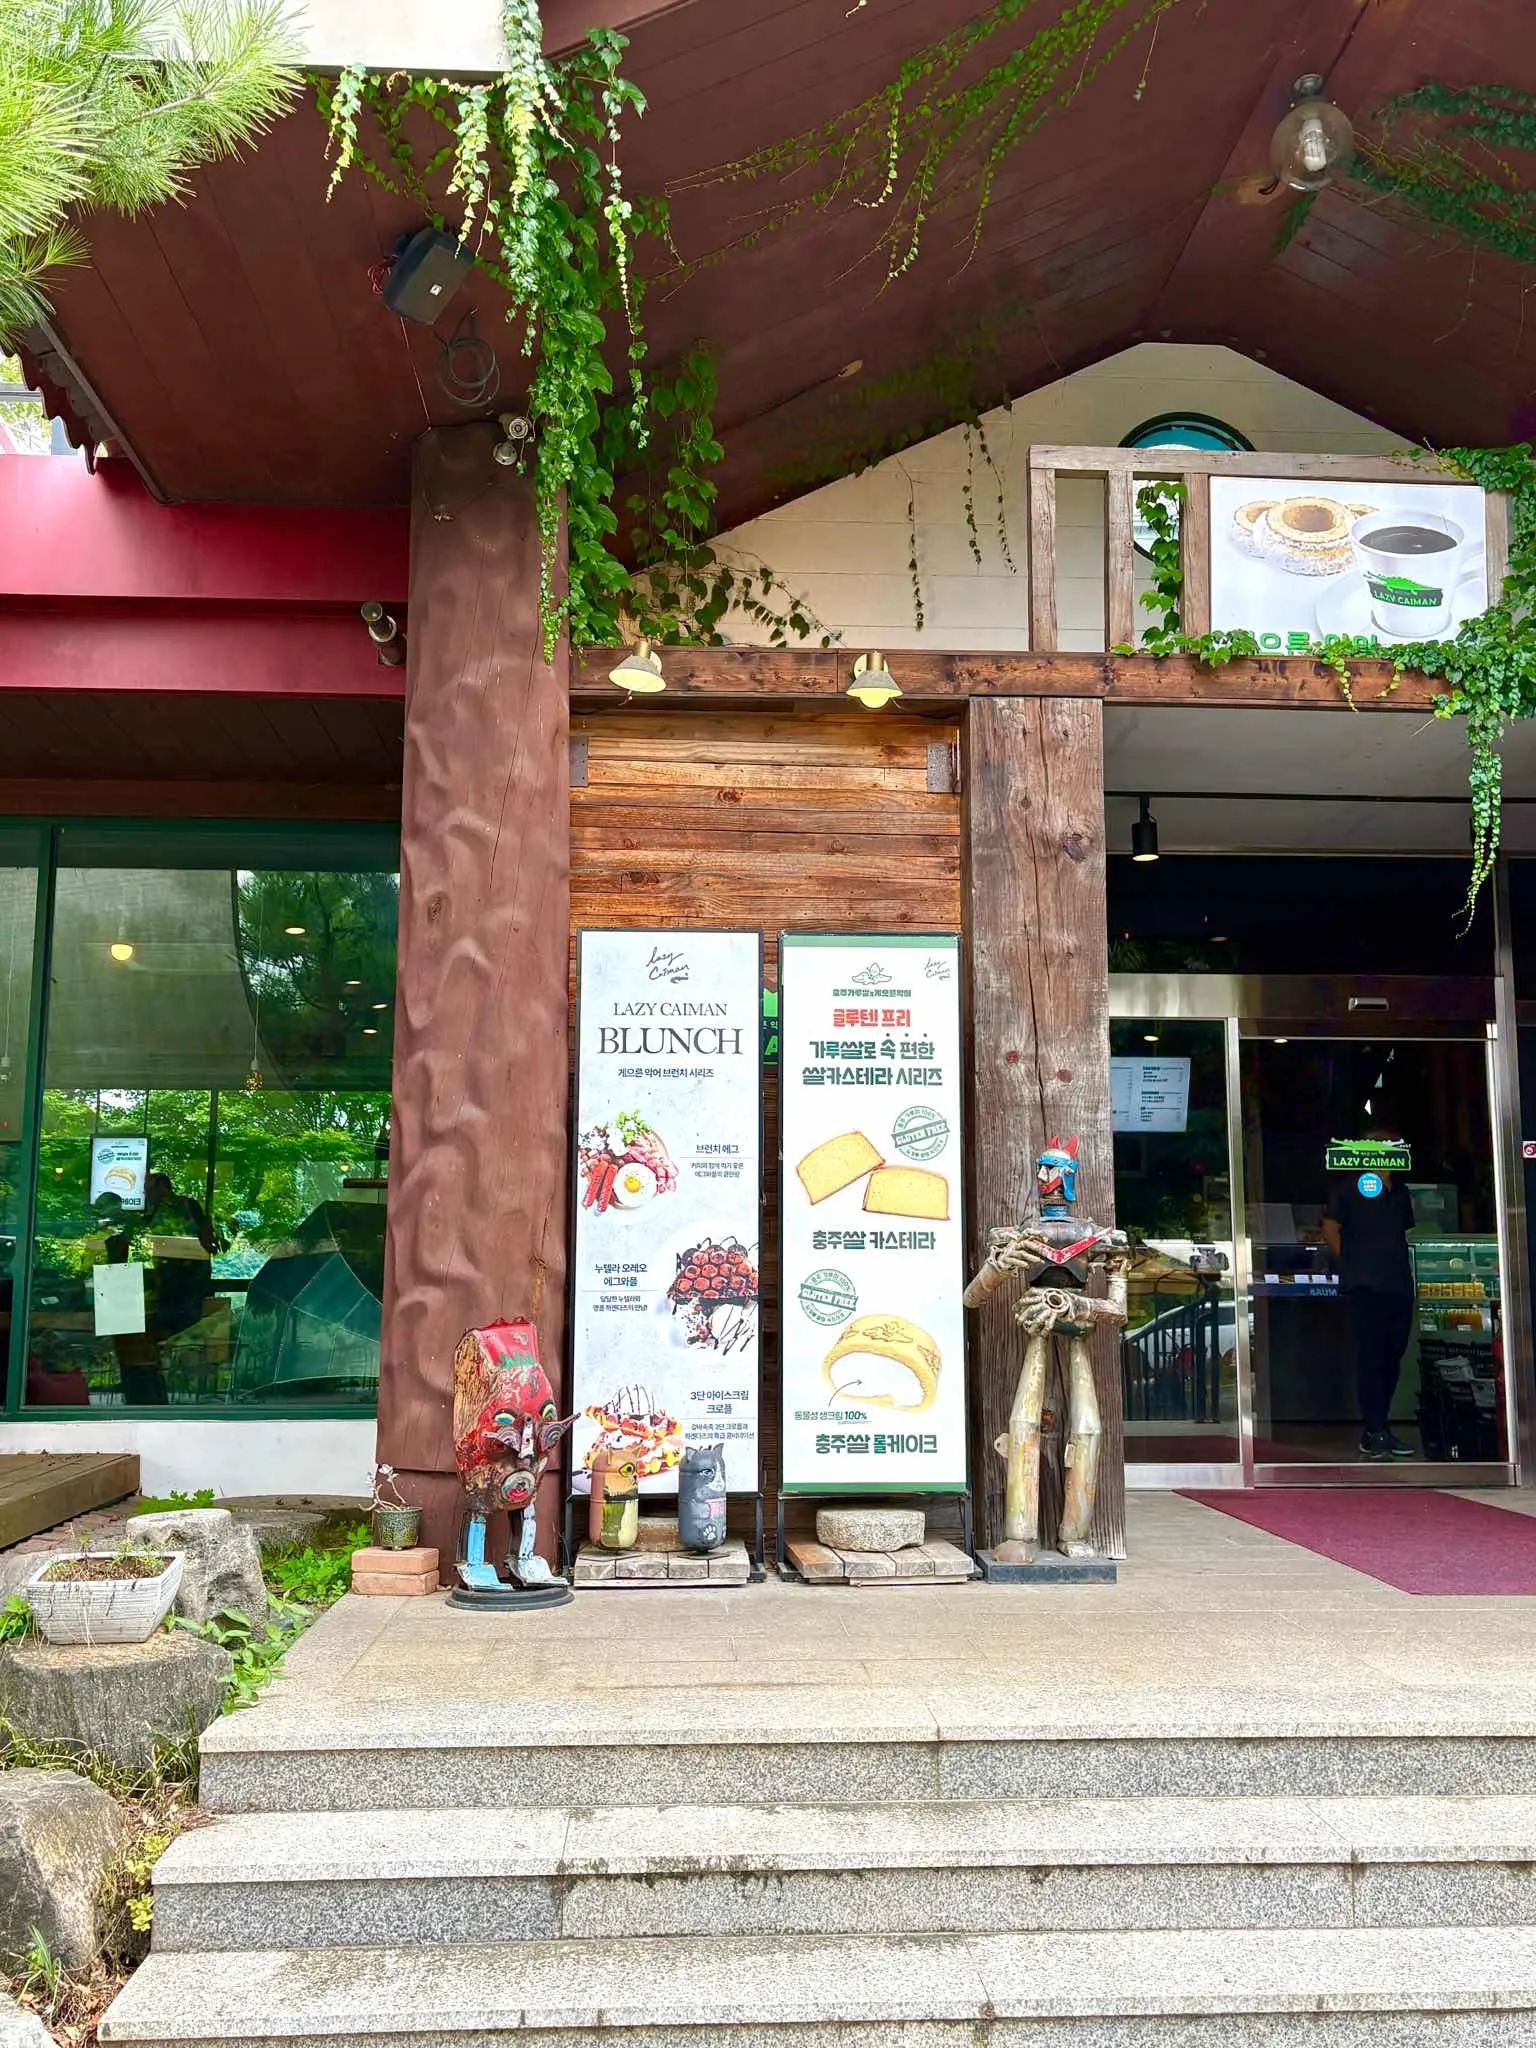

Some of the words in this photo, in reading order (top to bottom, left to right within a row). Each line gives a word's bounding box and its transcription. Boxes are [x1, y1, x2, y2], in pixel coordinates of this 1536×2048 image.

[1374, 590, 1397, 602] LAZY
[1397, 597, 1437, 606] CAIMAN
[613, 1002, 657, 1016] LAZY
[660, 1002, 728, 1017] CAIMAN
[833, 1008, 879, 1027] 글루텐
[881, 1008, 911, 1028] 프리
[598, 1026, 744, 1055] BLUNCH
[809, 1041, 877, 1060] 가루쌀로
[880, 1038, 896, 1060] 속
[899, 1041, 935, 1060] 편한
[618, 1068, 643, 1078] 게으른
[645, 1068, 662, 1078] 악어
[663, 1068, 688, 1078] 브런치
[689, 1068, 715, 1078] 시리즈
[802, 1066, 894, 1086] 쌀카스테라
[896, 1067, 943, 1086] 시리즈
[695, 1143, 721, 1154] 브런치
[721, 1143, 740, 1155] 에그
[1333, 1156, 1360, 1167] LAZY
[1362, 1156, 1405, 1167] CAIMAN
[812, 1230, 867, 1250] 충주쌀
[869, 1230, 936, 1250] 카스테라
[594, 1263, 620, 1274] 누텔라
[621, 1263, 648, 1273] 오레오
[603, 1276, 638, 1287] 에그와플
[690, 1390, 705, 1401] 3단
[706, 1390, 749, 1401] 아이스크림
[706, 1403, 733, 1414] 크로플
[794, 1410, 819, 1421] 동물성
[819, 1410, 843, 1421] 생크림
[844, 1410, 868, 1421] 100%
[815, 1433, 871, 1454] 충주쌀
[873, 1433, 938, 1454] 롤케이크
